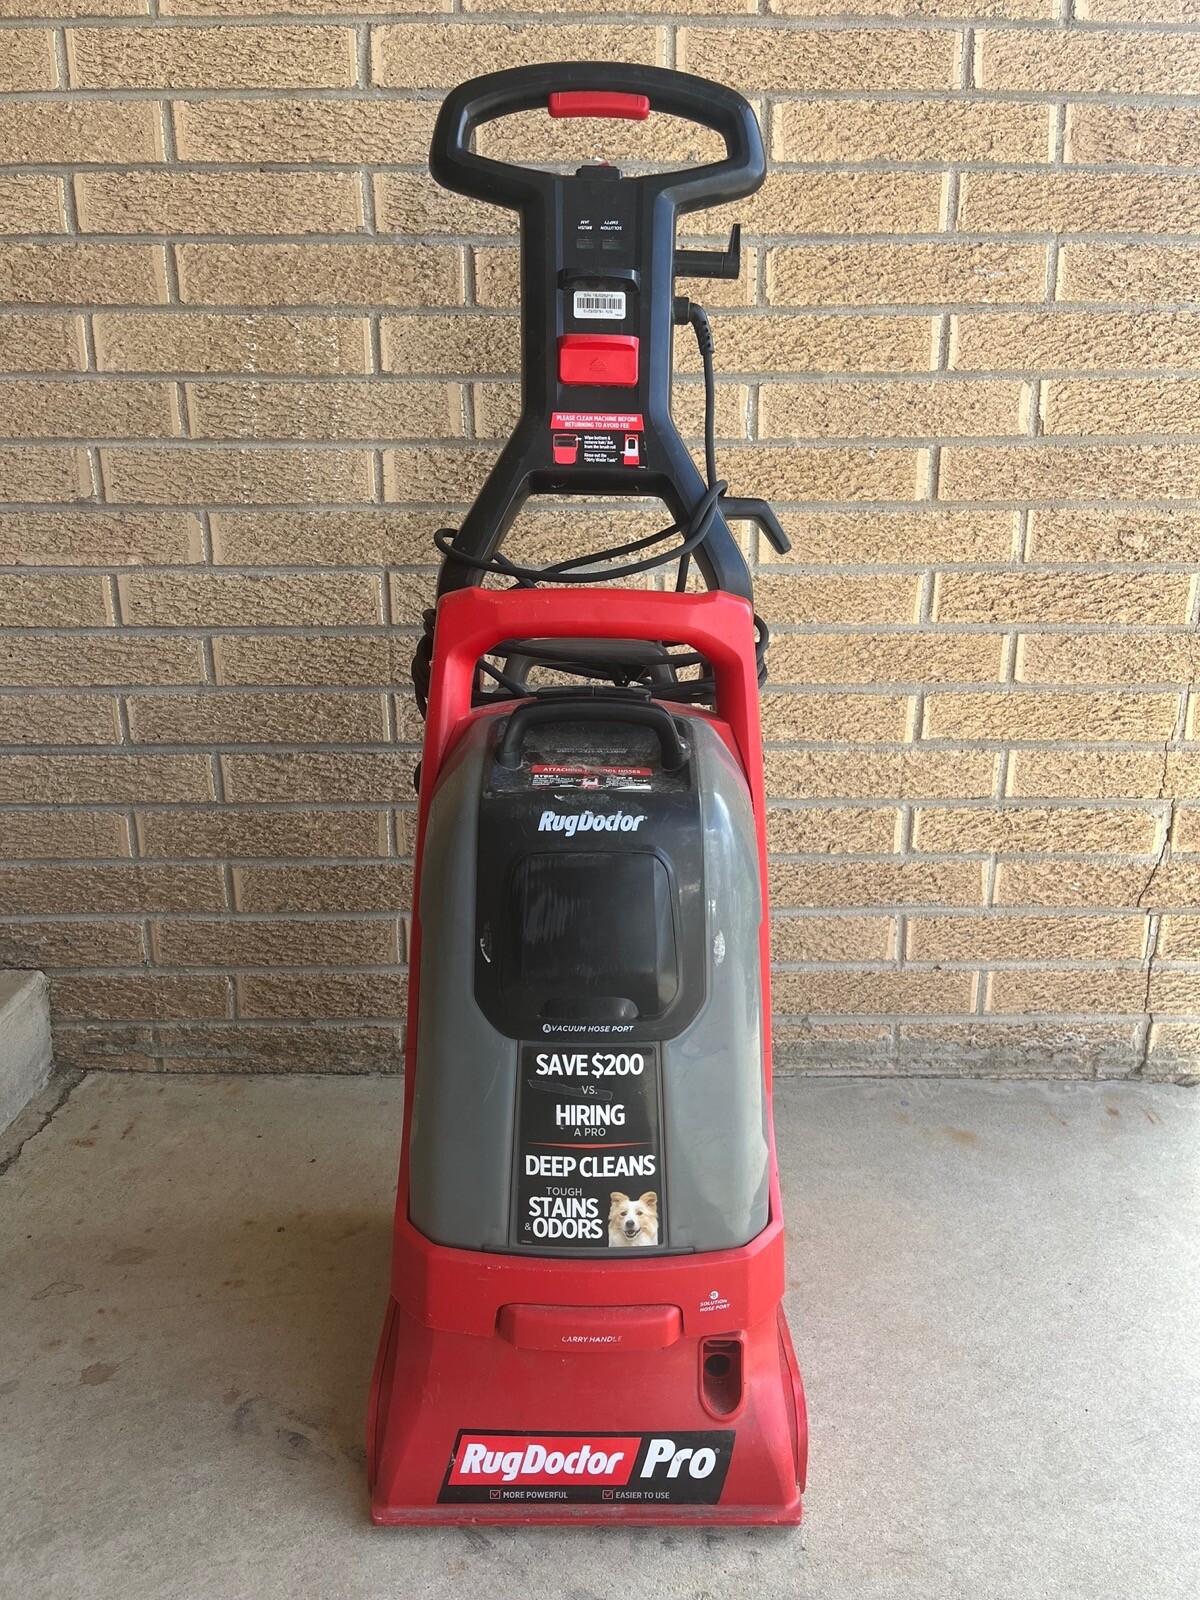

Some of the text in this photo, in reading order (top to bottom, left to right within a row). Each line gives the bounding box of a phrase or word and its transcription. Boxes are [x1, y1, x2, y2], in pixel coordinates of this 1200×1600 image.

[538, 810, 642, 837] RugDoctor
[535, 1053, 644, 1078] SAVE $200
[581, 1085, 598, 1095] VS.
[556, 1104, 626, 1126] HIRING
[573, 1127, 606, 1137] A PRO
[525, 1154, 656, 1178] DEEP CLEANS
[546, 1187, 583, 1197] TOUGH
[528, 1196, 599, 1218] STAINS
[524, 1217, 603, 1239] & ODORS
[700, 1299, 728, 1307] SOLUTION
[460, 1443, 624, 1481] RugDoctor
[503, 1491, 525, 1499] MORE
